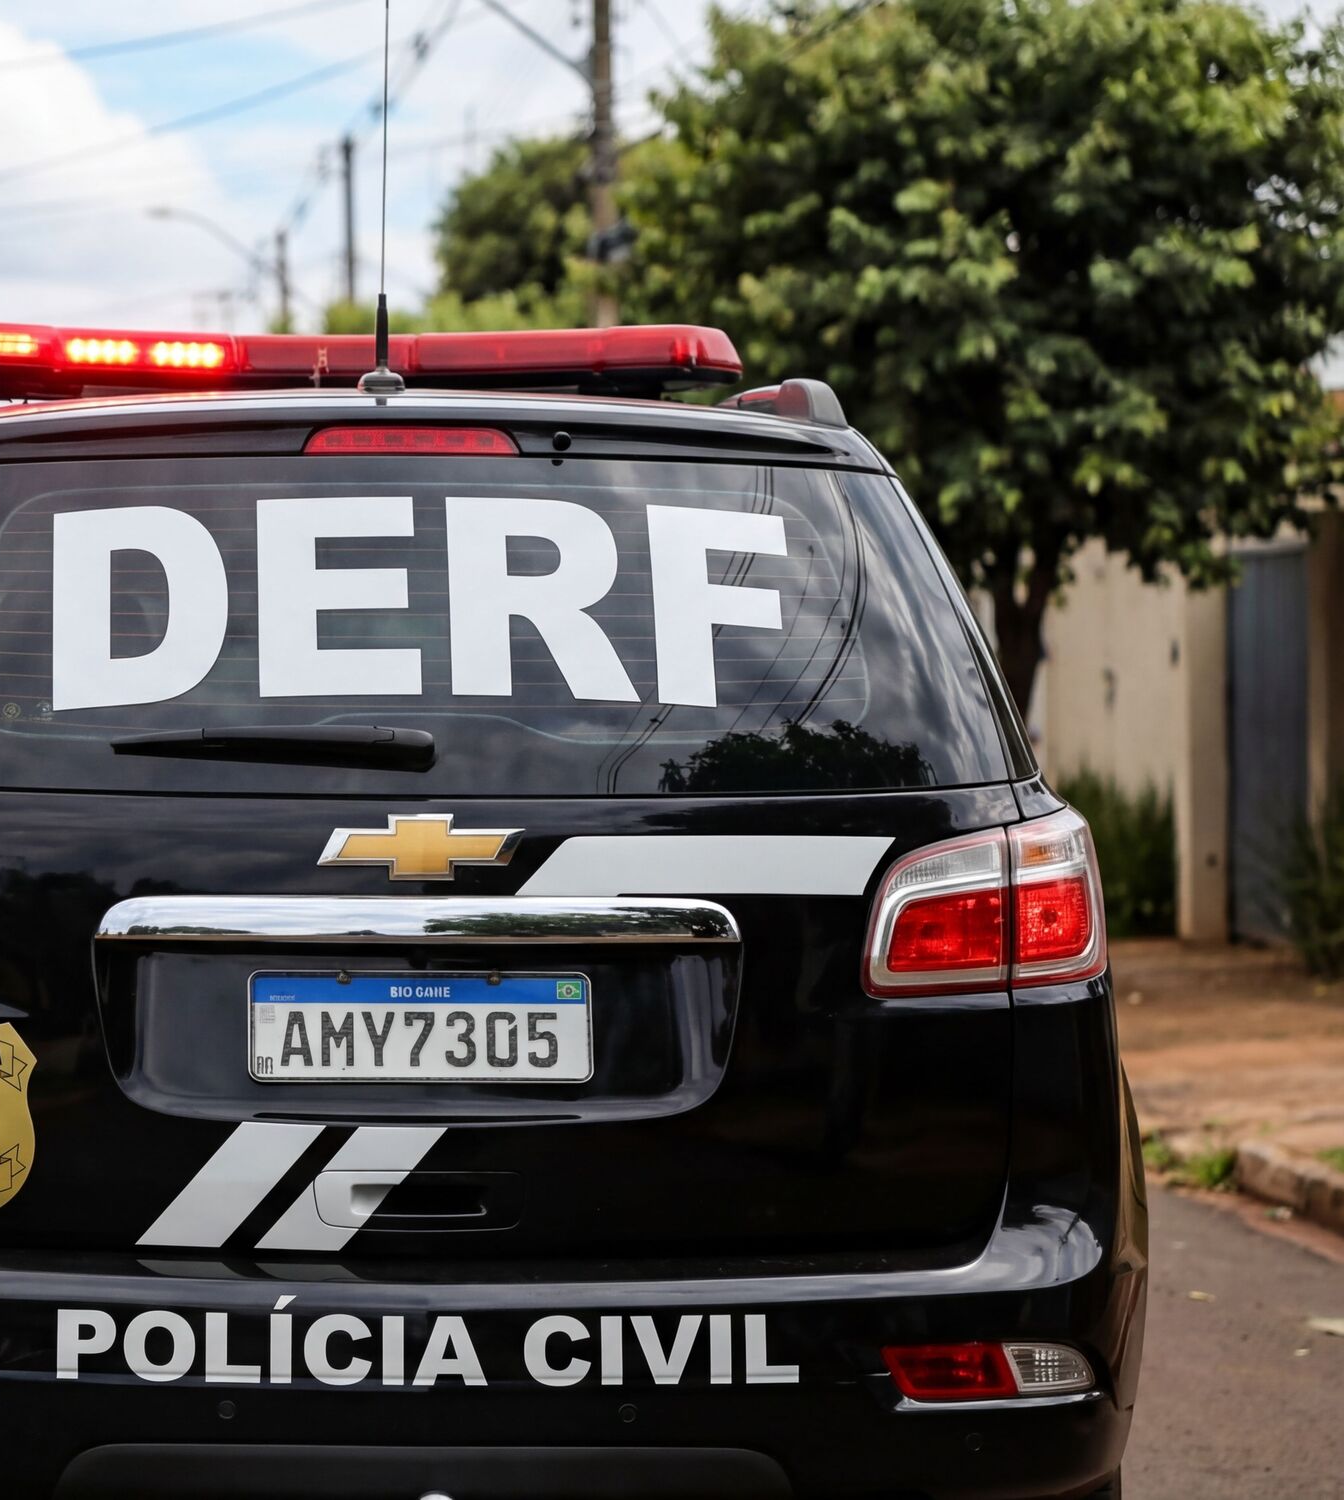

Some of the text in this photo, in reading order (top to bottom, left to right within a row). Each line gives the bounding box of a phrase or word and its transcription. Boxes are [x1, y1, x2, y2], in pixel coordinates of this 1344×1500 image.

[53, 497, 788, 711] DERF
[280, 1010, 560, 1068] AMY7305
[56, 1294, 800, 1387] POLÍCIA CIVIL
